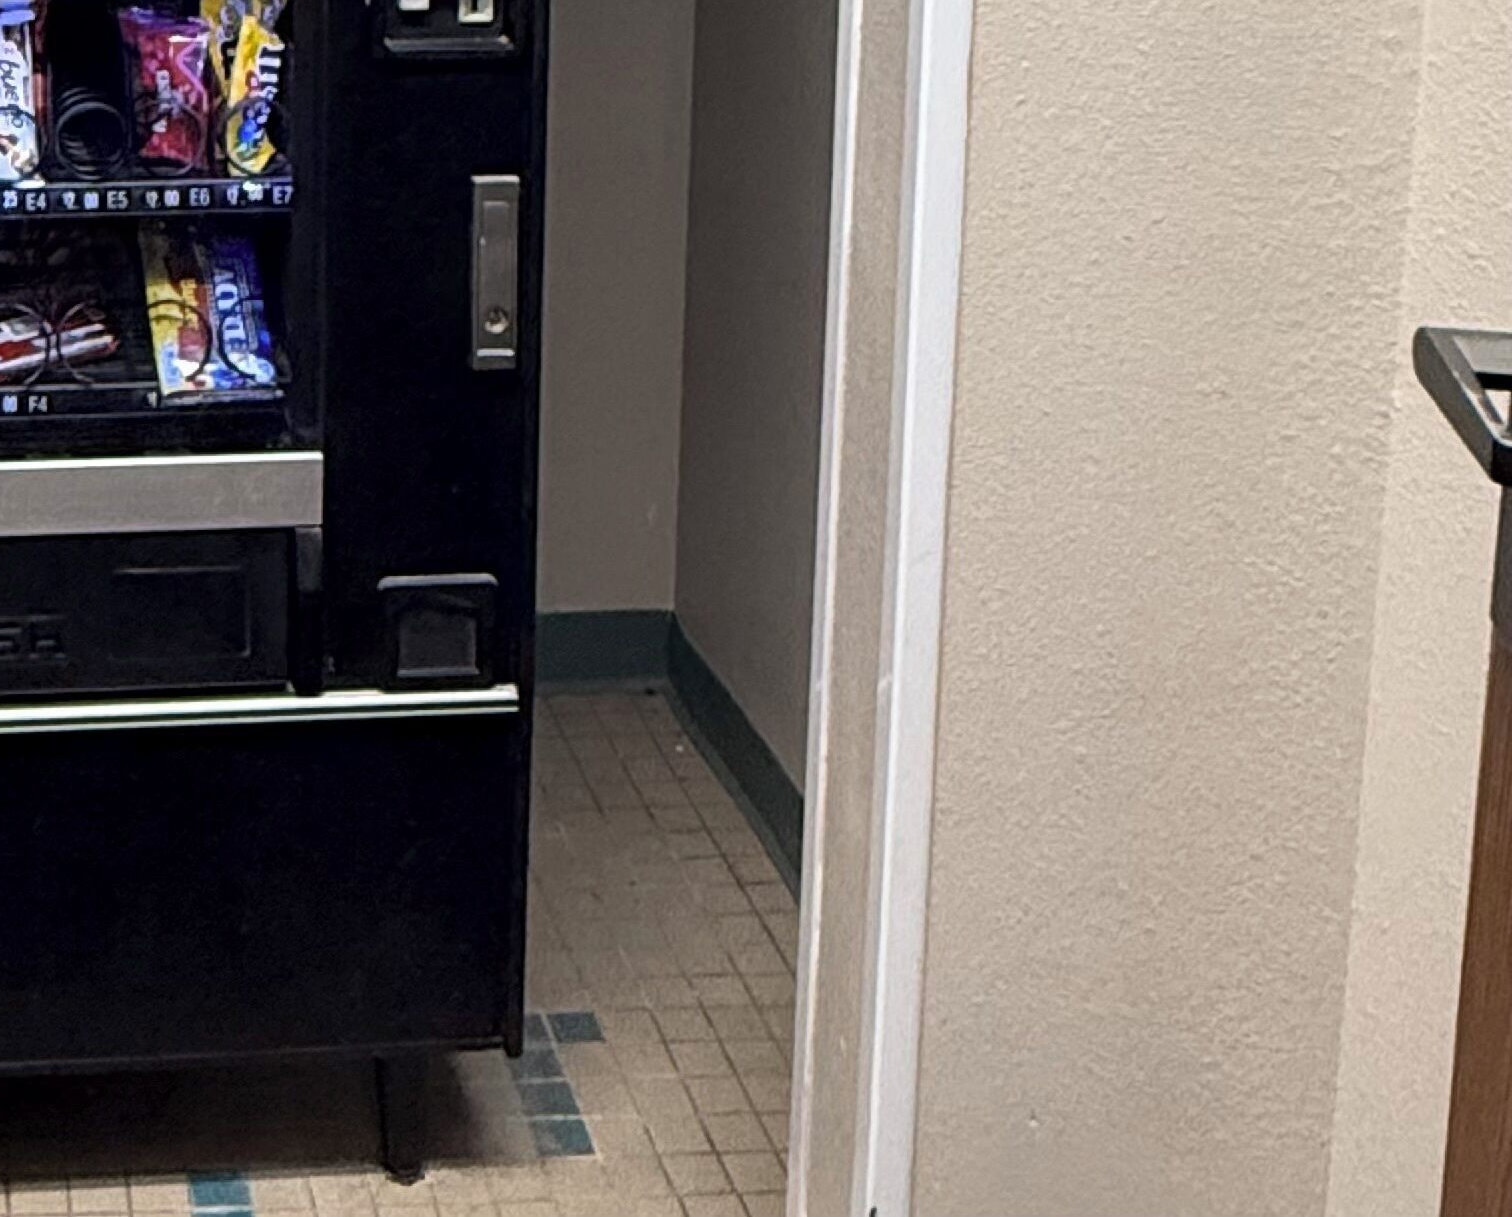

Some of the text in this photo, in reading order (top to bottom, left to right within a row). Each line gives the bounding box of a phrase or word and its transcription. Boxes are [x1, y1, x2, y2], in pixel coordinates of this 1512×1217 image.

[25, 192, 46, 211] E4
[106, 191, 129, 210] E5
[189, 187, 210, 206] E6
[272, 185, 293, 204] E7
[28, 395, 48, 413] F4
